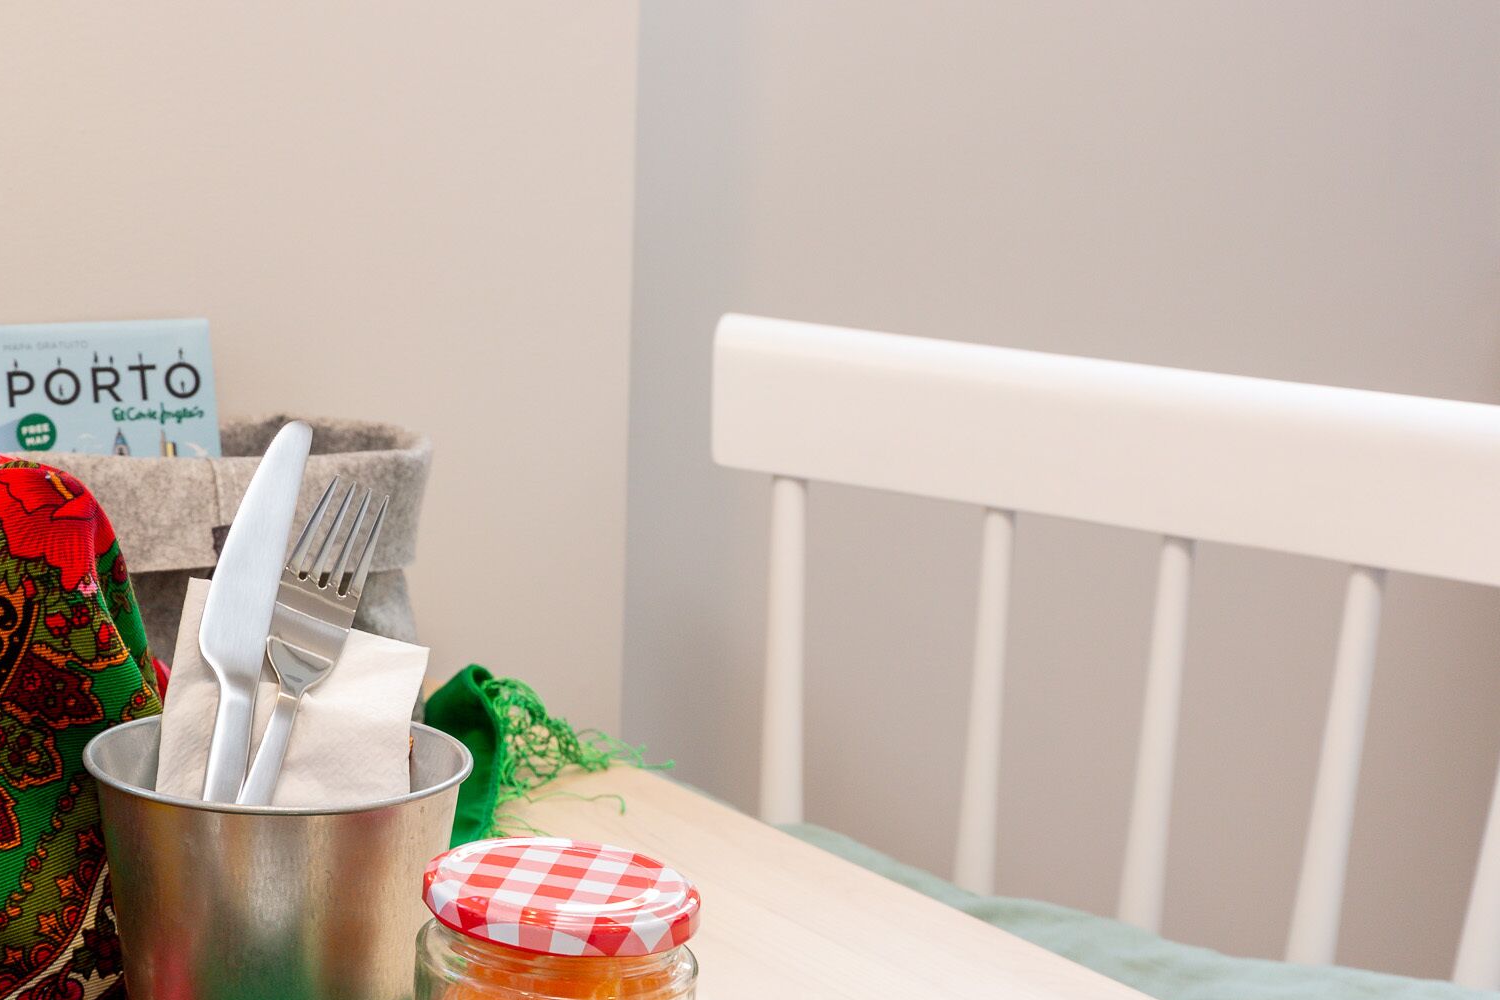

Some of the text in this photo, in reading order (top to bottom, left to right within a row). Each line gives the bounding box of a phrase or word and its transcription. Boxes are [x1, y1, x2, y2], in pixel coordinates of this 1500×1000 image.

[7, 361, 200, 408] PORTO
[112, 406, 125, 422] El
[21, 422, 50, 436] FREE
[25, 434, 50, 447] MAP
